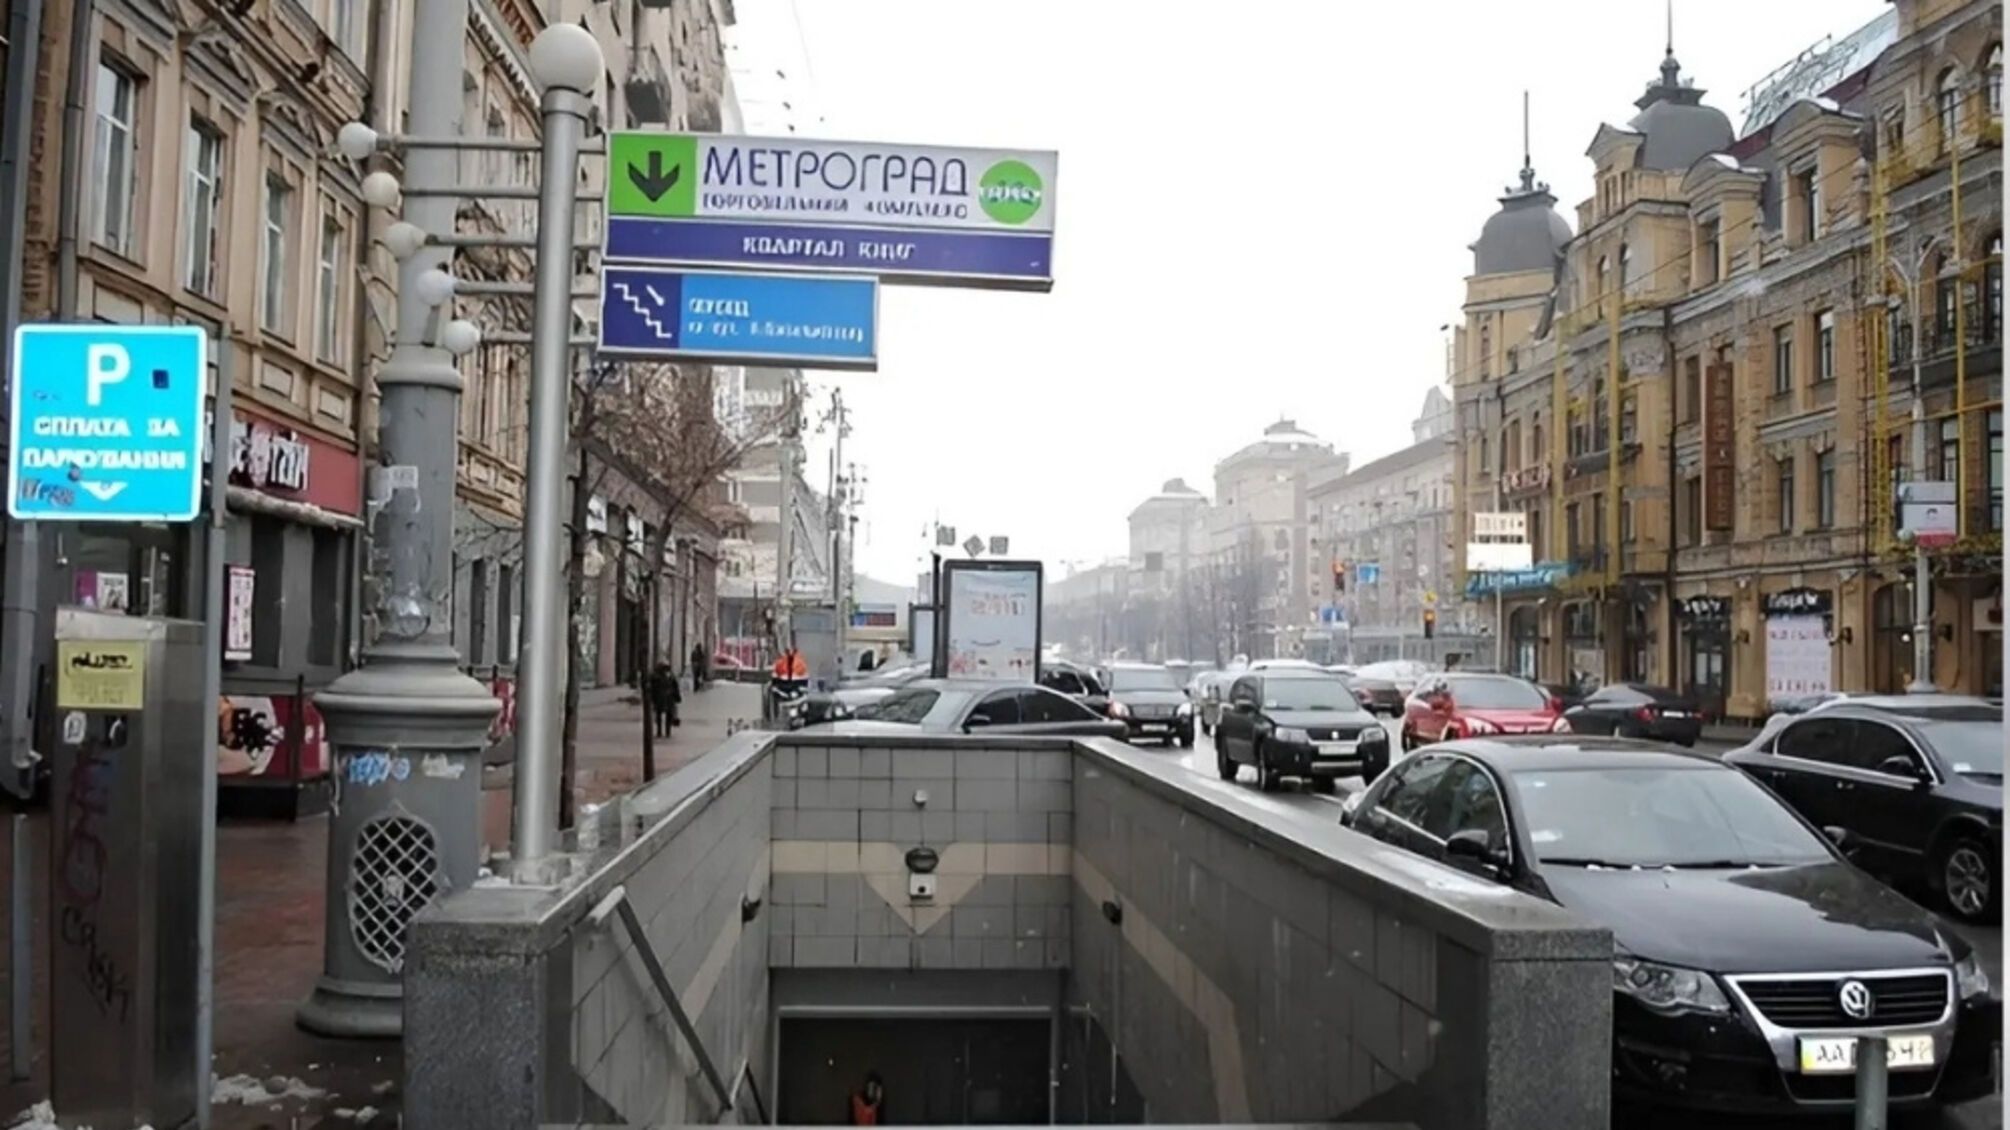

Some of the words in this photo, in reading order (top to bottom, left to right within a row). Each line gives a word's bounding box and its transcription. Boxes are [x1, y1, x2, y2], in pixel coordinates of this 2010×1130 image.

[703, 146, 969, 197] МЕТРОГРАД
[743, 237, 844, 257] КВАРТАЛ
[87, 342, 131, 407] P
[147, 418, 181, 437] ЗА
